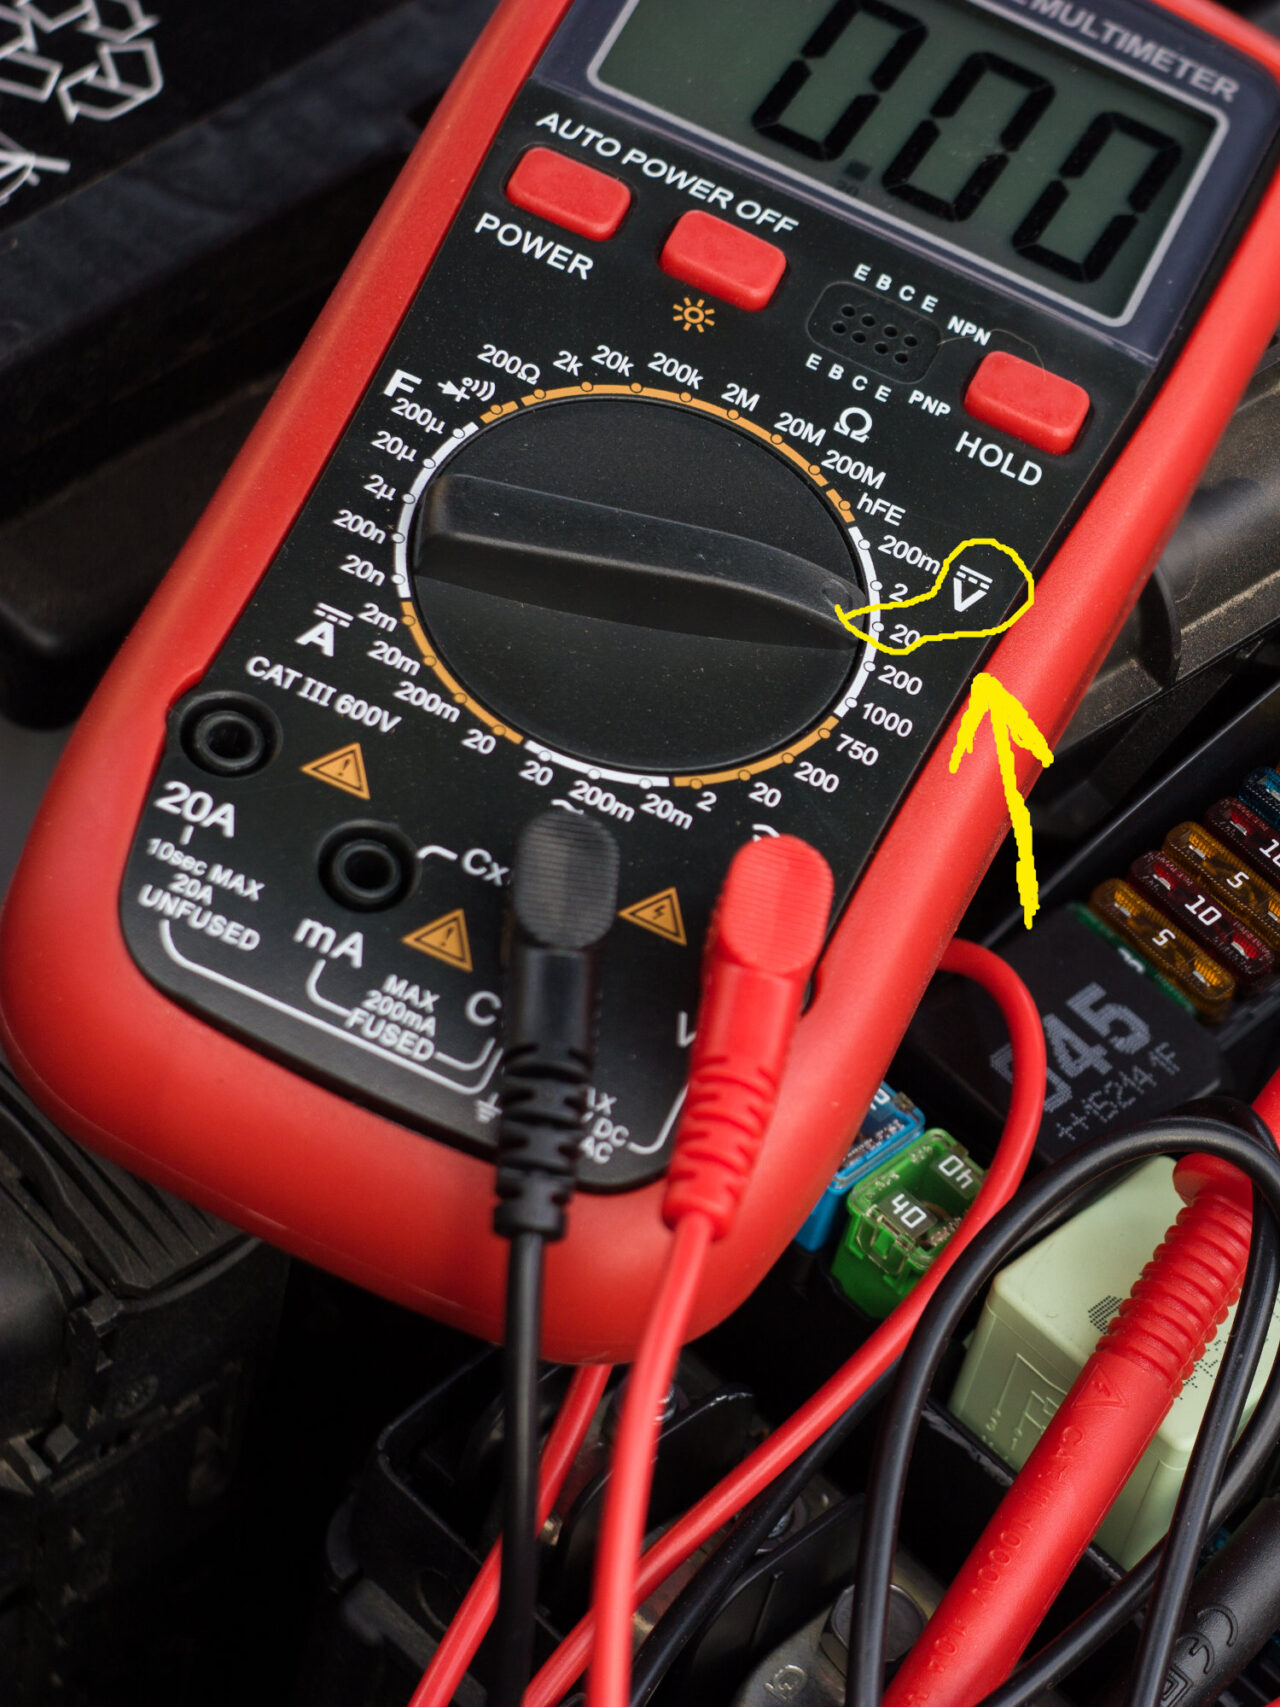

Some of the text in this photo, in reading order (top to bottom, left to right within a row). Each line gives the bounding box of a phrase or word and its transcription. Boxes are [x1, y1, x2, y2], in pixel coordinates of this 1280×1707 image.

[1031, 0, 1240, 103] MULTIMETER
[536, 112, 799, 237] AUTO POWER OFF
[474, 214, 594, 280] POWER
[947, 315, 992, 346] NPN
[477, 344, 541, 386] 200Ω
[552, 350, 583, 377] 2k
[591, 345, 635, 378] 20k
[647, 351, 704, 391] 200k
[383, 369, 422, 397] F
[721, 382, 760, 412] 2M
[908, 390, 951, 417] PNP
[774, 412, 826, 447] 20M
[821, 449, 887, 490] 200M
[954, 432, 1043, 487] HOLD
[332, 509, 386, 545] 200n
[857, 492, 906, 527] hFE
[339, 554, 386, 587] 20n
[878, 535, 942, 575] 200m
[889, 583, 907, 602] 2
[953, 577, 987, 612] V
[357, 602, 399, 633] 2m
[890, 624, 921, 647] 20
[295, 620, 336, 657] A
[367, 640, 421, 677] 20m
[245, 655, 402, 734] CAT III 600V
[878, 664, 923, 696] 200
[394, 681, 461, 723] 200m
[862, 702, 913, 739] 1000
[462, 728, 496, 755] 20
[837, 734, 879, 767] 750
[519, 760, 554, 787] 20
[794, 761, 839, 794] 200
[154, 780, 237, 839] 20A
[568, 779, 635, 822] 200m
[640, 793, 693, 830] 20m
[697, 791, 718, 812] 2
[748, 782, 782, 809] 20
[147, 838, 265, 902] 10sec MAX
[1225, 871, 1251, 889] 5
[167, 873, 214, 905] 20A
[138, 884, 261, 953] UNFUSED
[1184, 894, 1223, 927] 10
[293, 917, 365, 969] mA
[1152, 928, 1176, 947] 5
[382, 974, 440, 1014] MAX
[362, 989, 438, 1037] 200mA
[345, 1008, 436, 1063] FUSED
[938, 1154, 974, 1190] 40
[892, 1193, 927, 1229] 40
